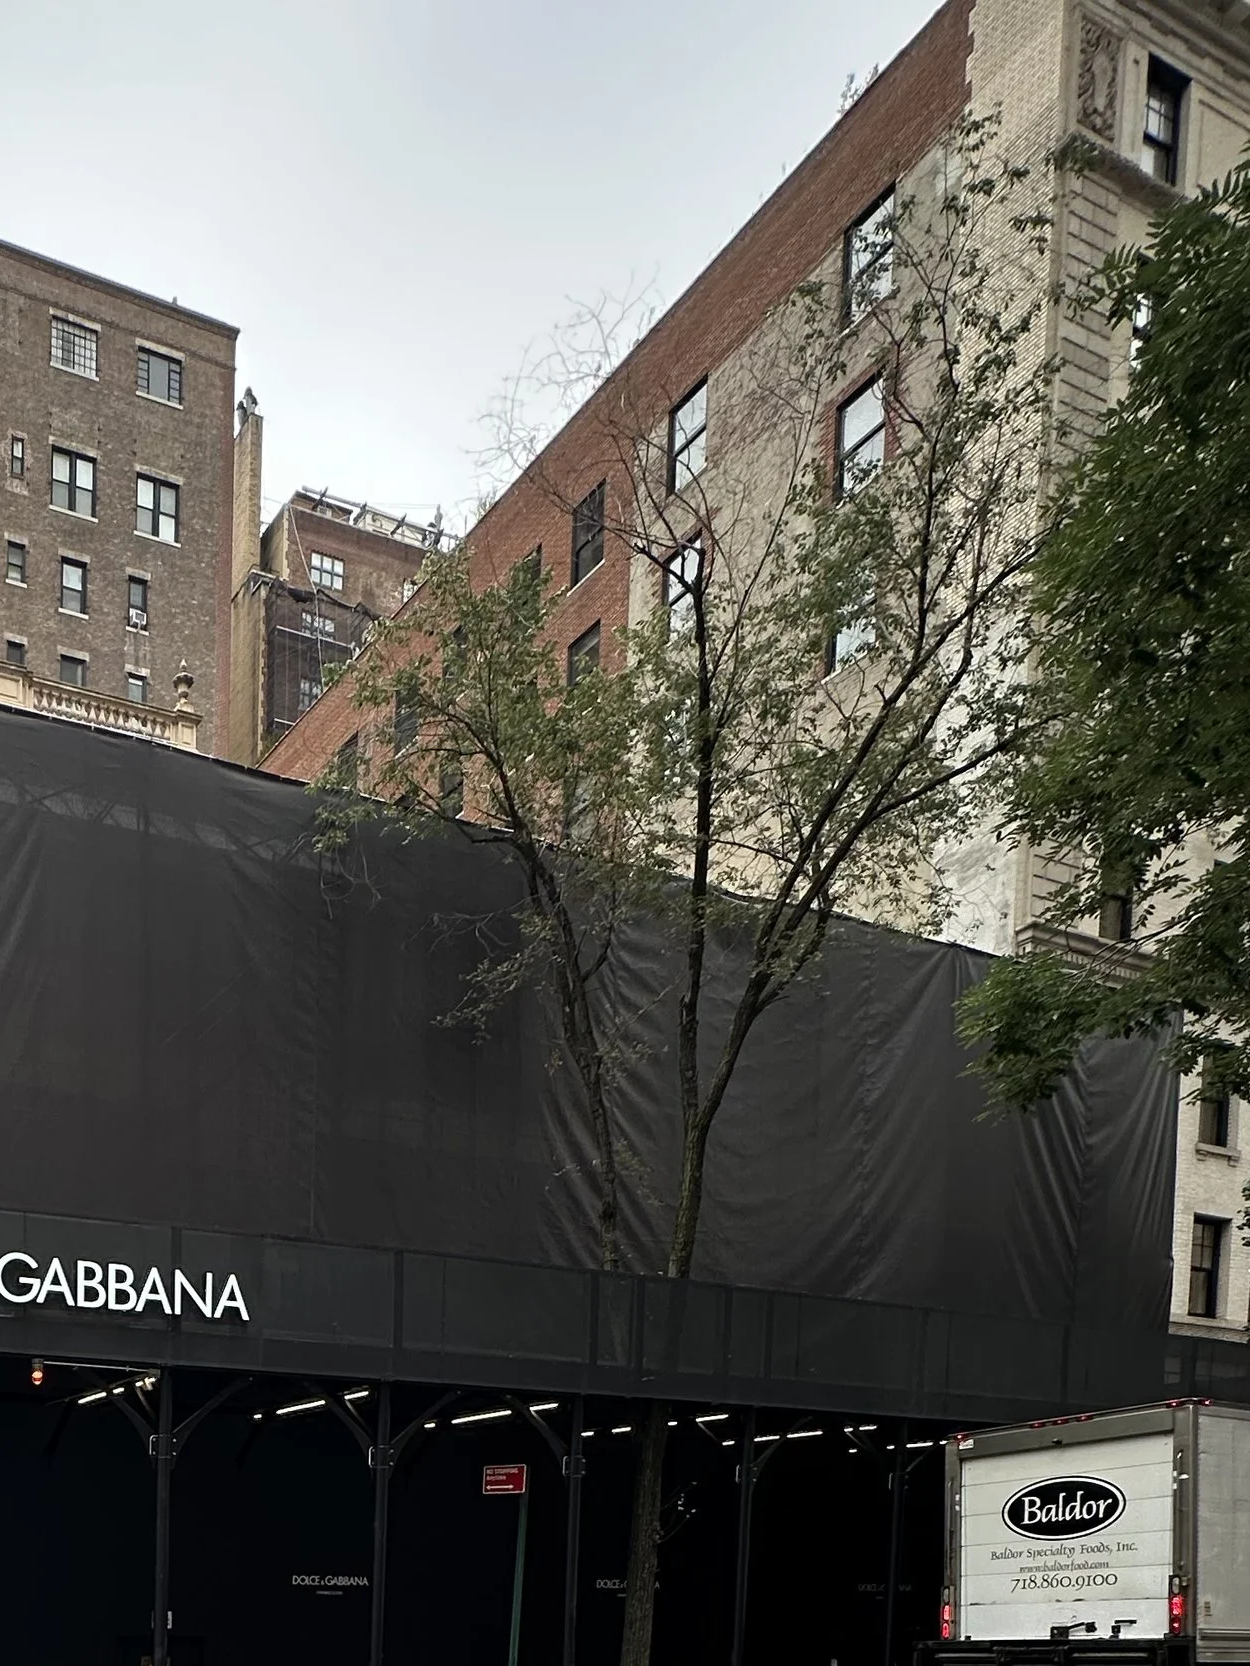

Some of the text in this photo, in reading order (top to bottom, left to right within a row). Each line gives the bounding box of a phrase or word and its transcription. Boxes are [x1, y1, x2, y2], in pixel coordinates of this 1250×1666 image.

[1020, 1490, 1113, 1526] Baldor
[990, 1541, 1138, 1561] Baldor Specialty Foods, Inc.
[1019, 1559, 1110, 1573] www.baldorfood.com
[292, 1575, 320, 1586] DOLCE
[325, 1575, 369, 1587] GABBANA
[1010, 1573, 1118, 1593] 718.860.9100
